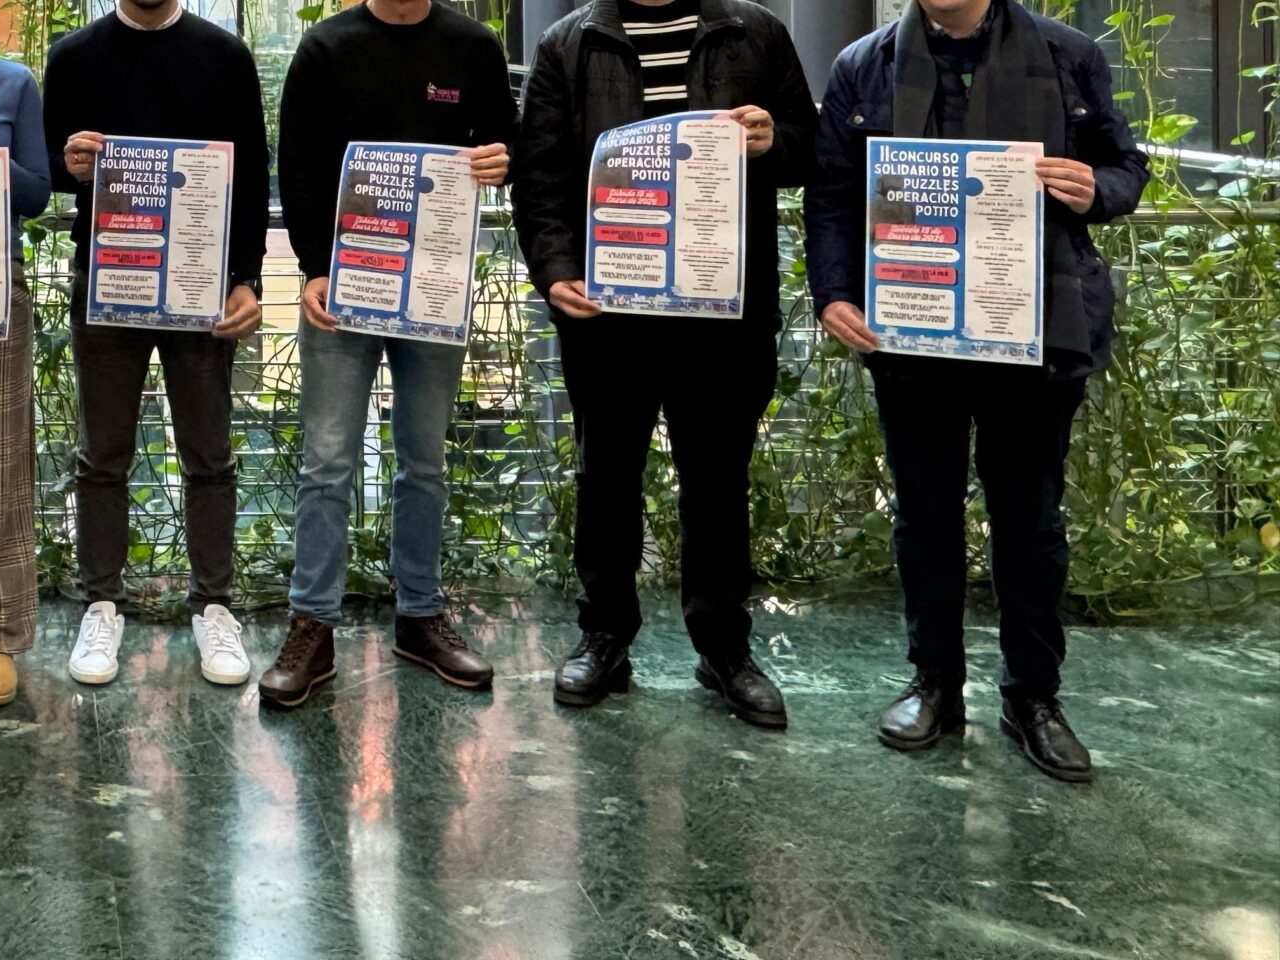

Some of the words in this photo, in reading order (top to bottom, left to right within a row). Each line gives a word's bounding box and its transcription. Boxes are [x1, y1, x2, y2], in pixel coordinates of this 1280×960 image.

[616, 123, 672, 137] CONCURSO
[656, 134, 671, 144] DE
[114, 147, 168, 160] CONCURSO
[362, 150, 418, 164] CONCURSO
[622, 146, 671, 157] PUZZLES
[890, 150, 960, 164] CONCURSO
[100, 159, 152, 171] SOLIDARIO
[154, 161, 168, 172] DE
[348, 160, 400, 174] SOLIDARIO
[402, 164, 417, 176] DE
[606, 157, 671, 169] OPERACIÓN
[631, 169, 671, 181] POTITO
[874, 164, 939, 176] SOLIDARIO
[943, 166, 960, 177] DE
[123, 172, 168, 184] PUZZLES
[369, 173, 415, 188] PUZZLES
[903, 178, 959, 191] PUZZLES
[109, 183, 167, 196] OPERACIÓN
[354, 184, 414, 200] OPERACIÓN
[131, 196, 166, 208] POTITO
[887, 189, 959, 205] OPERACIÓN
[377, 199, 412, 213] POTITO
[916, 205, 959, 218] POTITO
